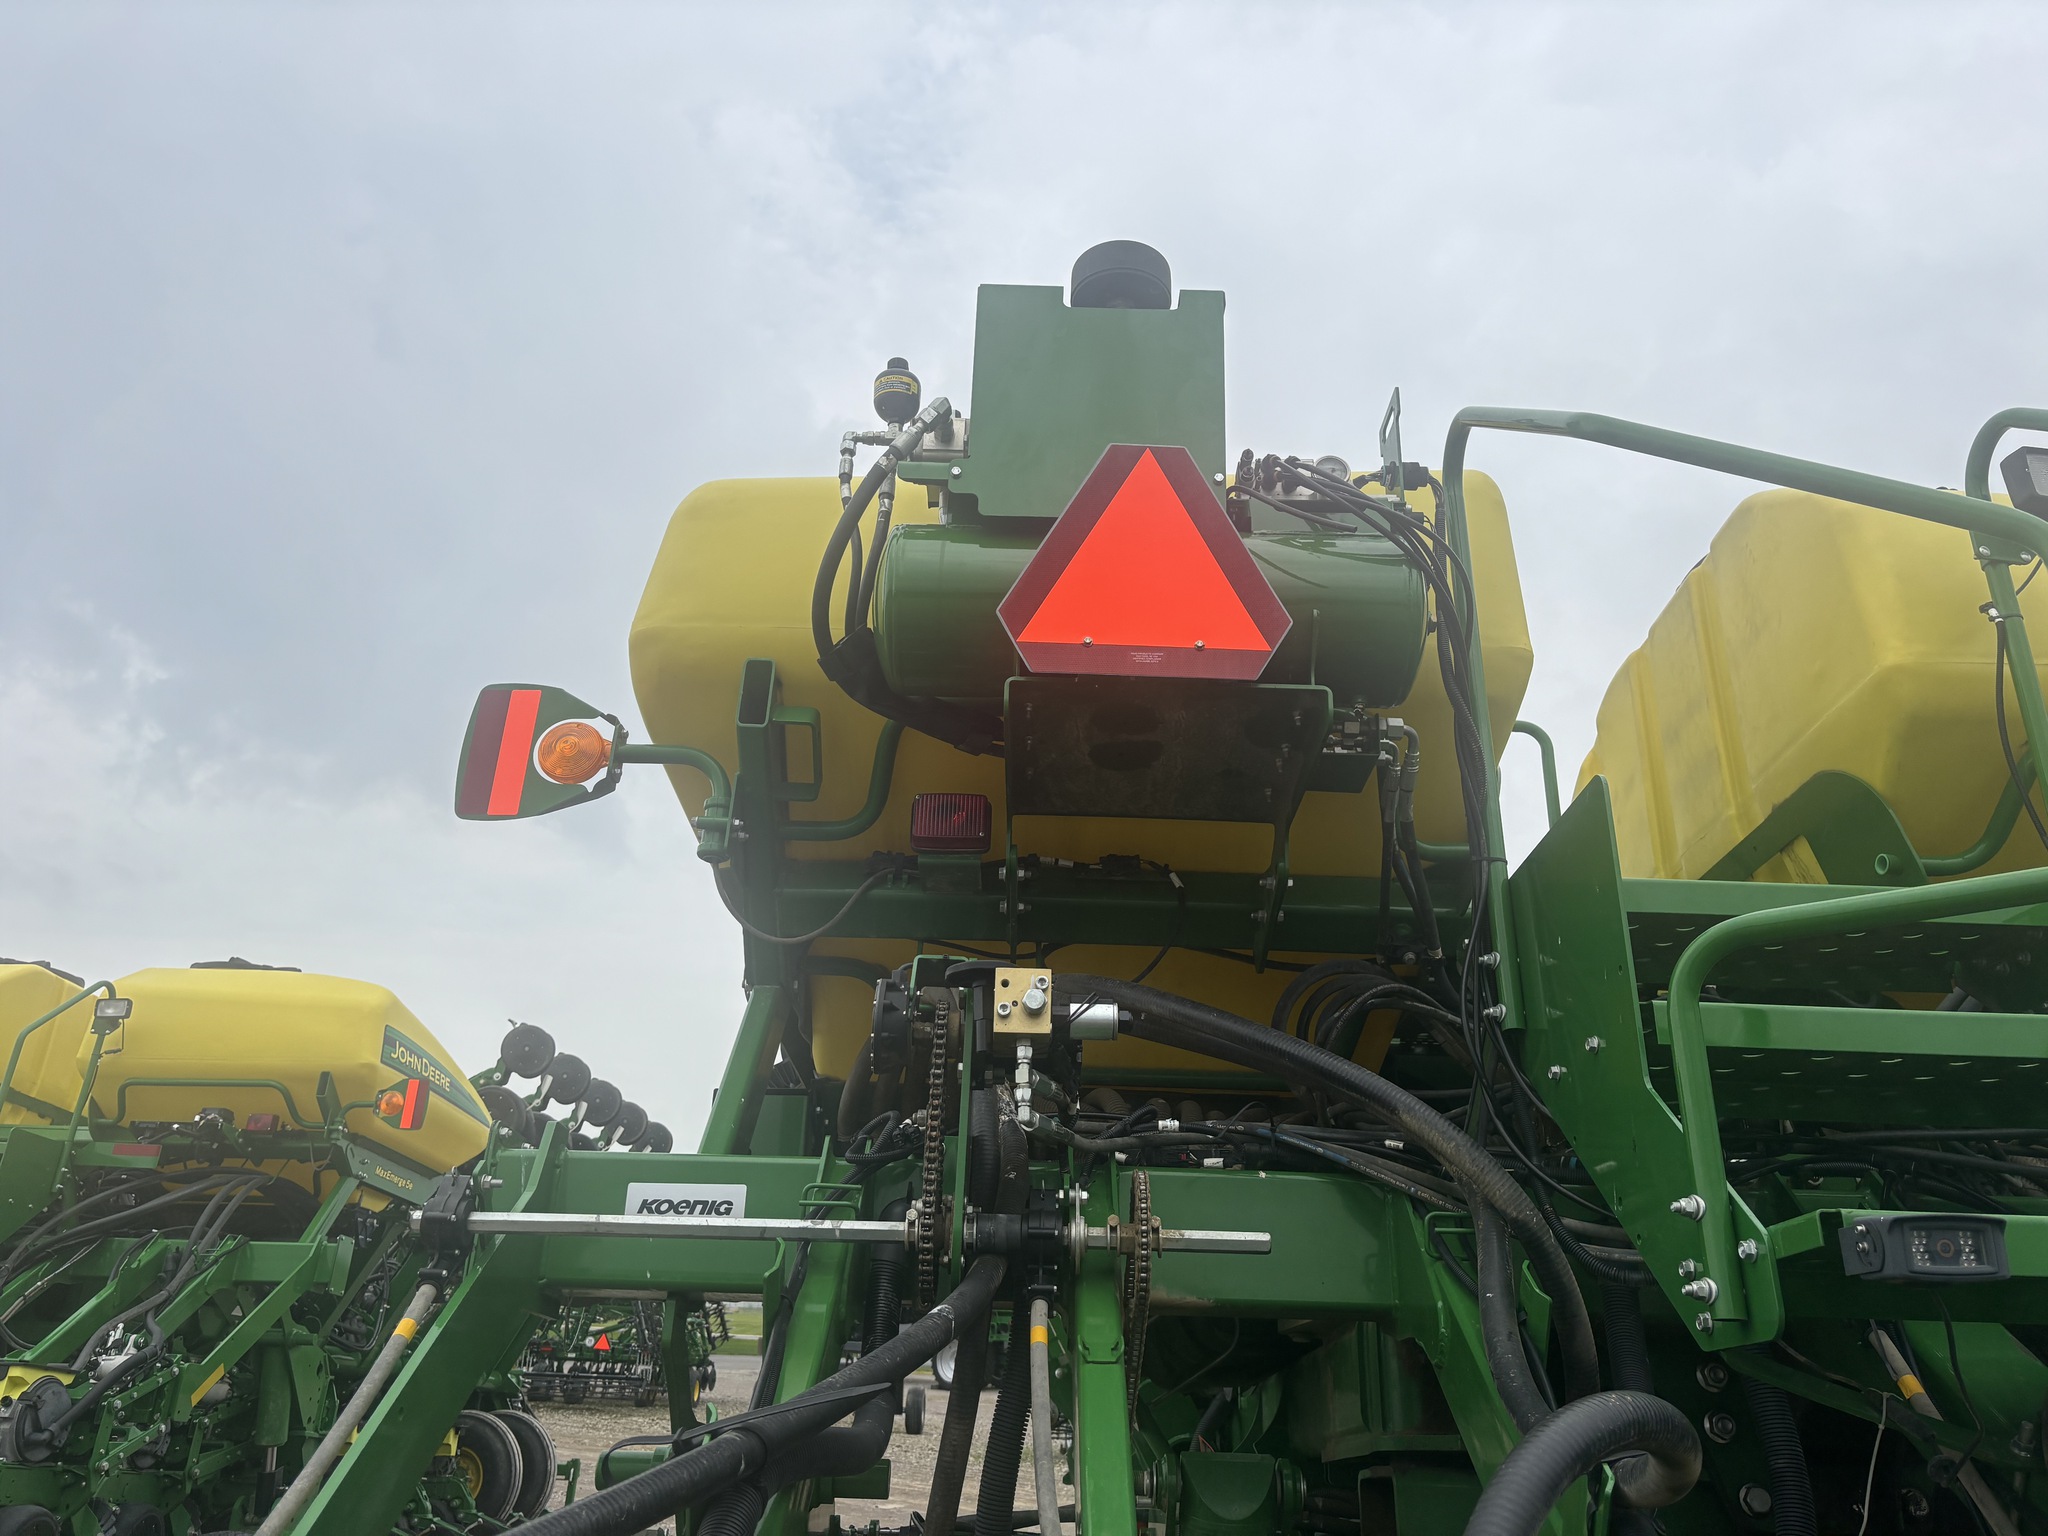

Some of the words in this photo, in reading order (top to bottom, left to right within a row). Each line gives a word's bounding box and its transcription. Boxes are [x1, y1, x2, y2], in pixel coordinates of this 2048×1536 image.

[391, 1041, 421, 1073] JOHN
[422, 1057, 450, 1092] DEERE
[375, 1165, 406, 1187] MaxEmerge
[406, 1180, 413, 1190] 5e
